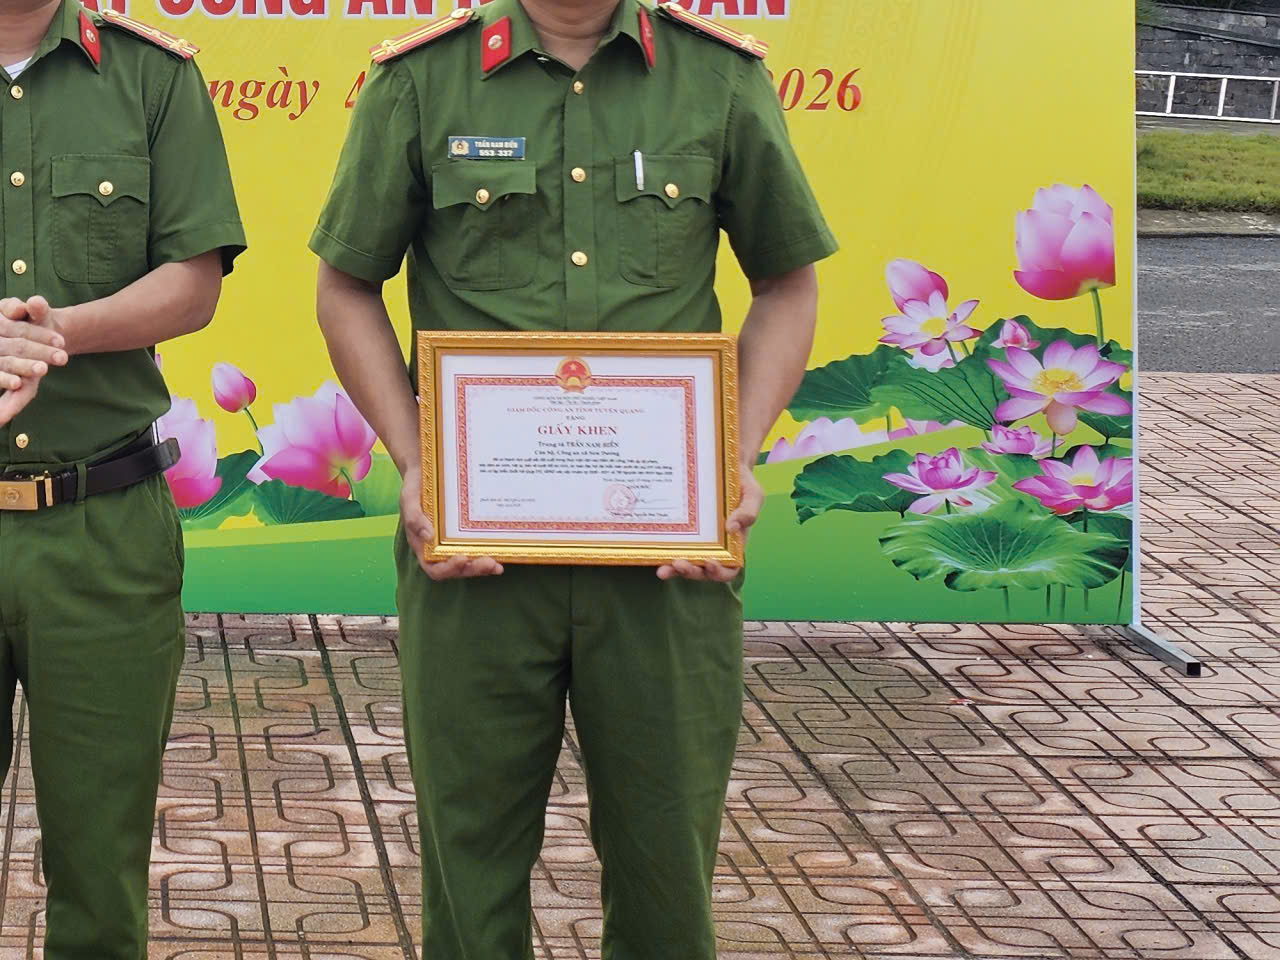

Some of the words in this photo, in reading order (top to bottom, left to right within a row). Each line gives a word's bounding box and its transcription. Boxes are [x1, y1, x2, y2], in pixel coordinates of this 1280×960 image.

[207, 66, 320, 121] ngày
[767, 68, 862, 111] 026
[537, 422, 572, 436] GIẤY
[577, 425, 618, 436] KHEN
